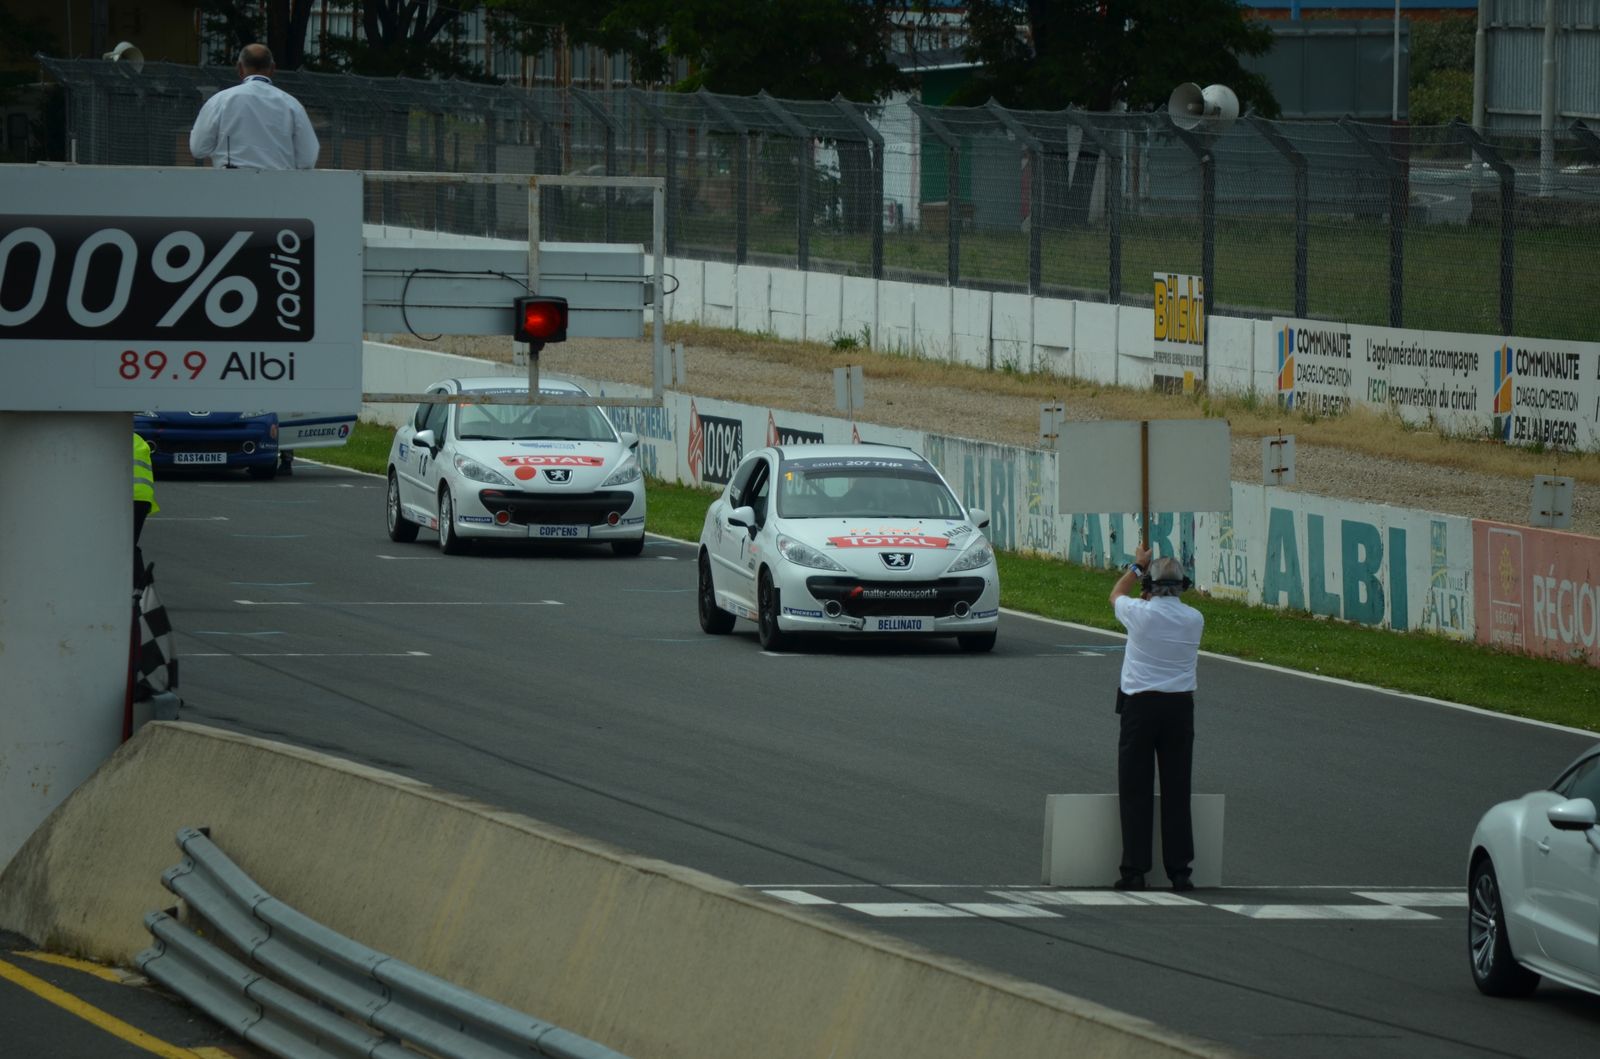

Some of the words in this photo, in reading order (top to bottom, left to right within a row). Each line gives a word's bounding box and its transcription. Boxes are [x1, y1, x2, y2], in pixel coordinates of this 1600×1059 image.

[270, 229, 300, 331] radio
[1154, 275, 1203, 345] Bilski
[119, 350, 207, 381] 89.9
[220, 351, 295, 381] Albi
[1429, 348, 1479, 378] accompagne
[1439, 381, 1449, 408] du
[1451, 384, 1478, 411] circuit
[511, 456, 593, 465] TOTAL
[844, 536, 937, 547] TOTAL
[1262, 507, 1409, 632] ALBI
[863, 588, 939, 600] matter-motorsport.fr
[1533, 564, 1600, 648] RÉGIO
[878, 619, 922, 630] BELLINATO
